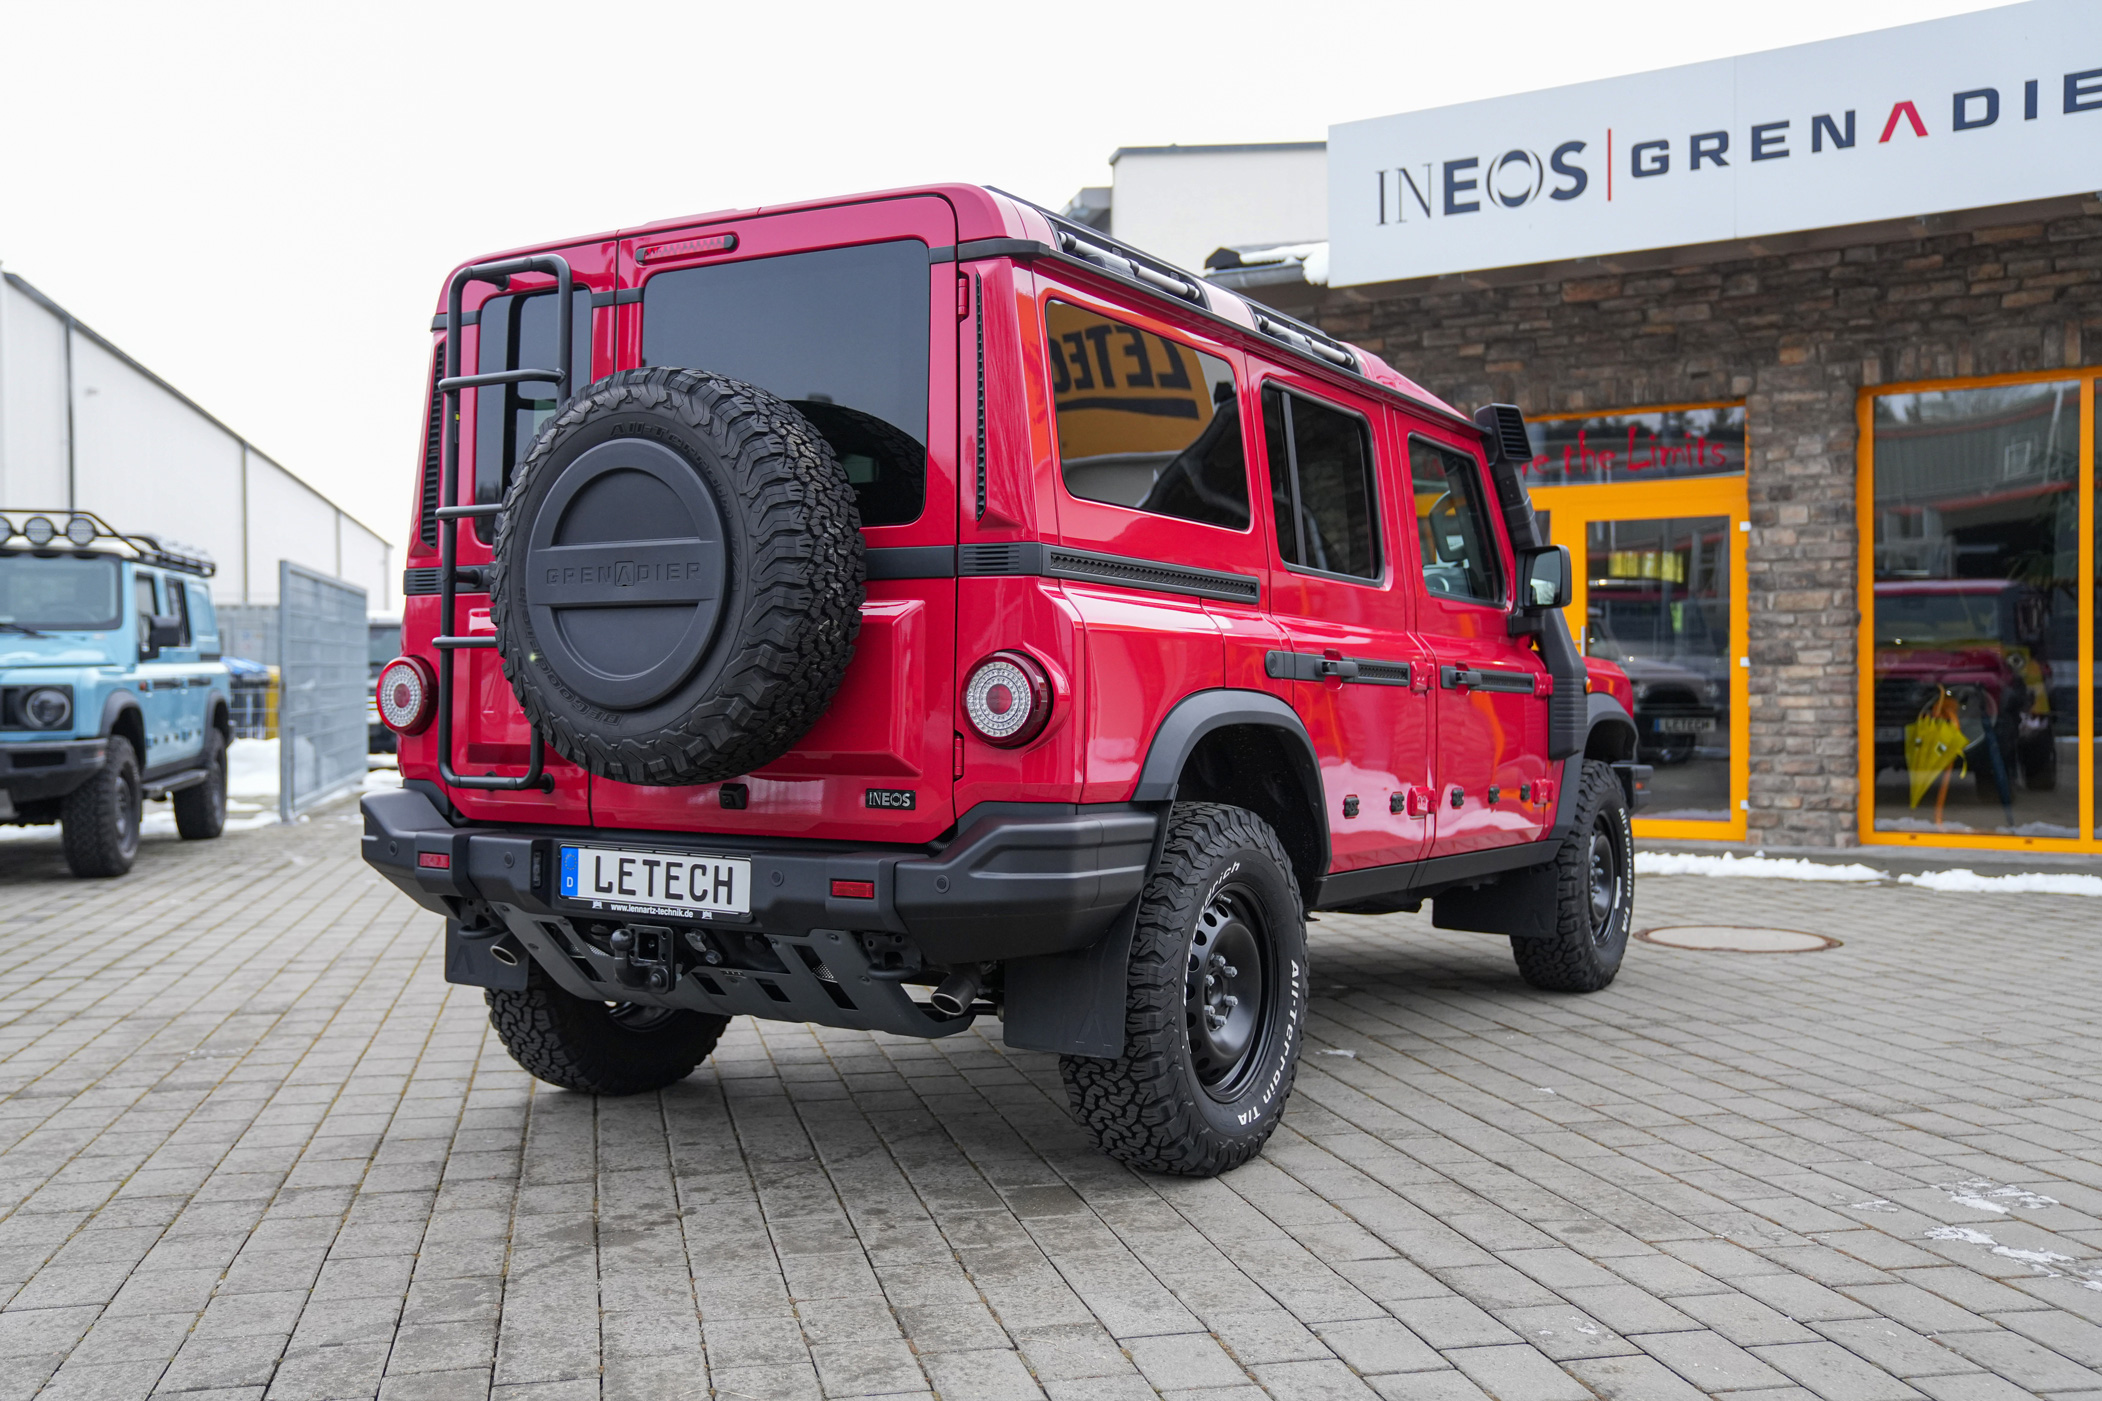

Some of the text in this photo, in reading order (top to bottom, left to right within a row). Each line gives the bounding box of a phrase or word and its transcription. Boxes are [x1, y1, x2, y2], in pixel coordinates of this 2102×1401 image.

[1375, 140, 1588, 226] INEOS
[1561, 429, 1616, 476] the
[1627, 425, 1726, 472] Limits
[546, 561, 702, 587] GRENADIER
[868, 791, 911, 807] INEOS
[566, 855, 733, 905] D LETECH
[610, 903, 694, 918] www.lennartz-technik.de
[1237, 959, 1300, 1126] All-Terrain T/A
